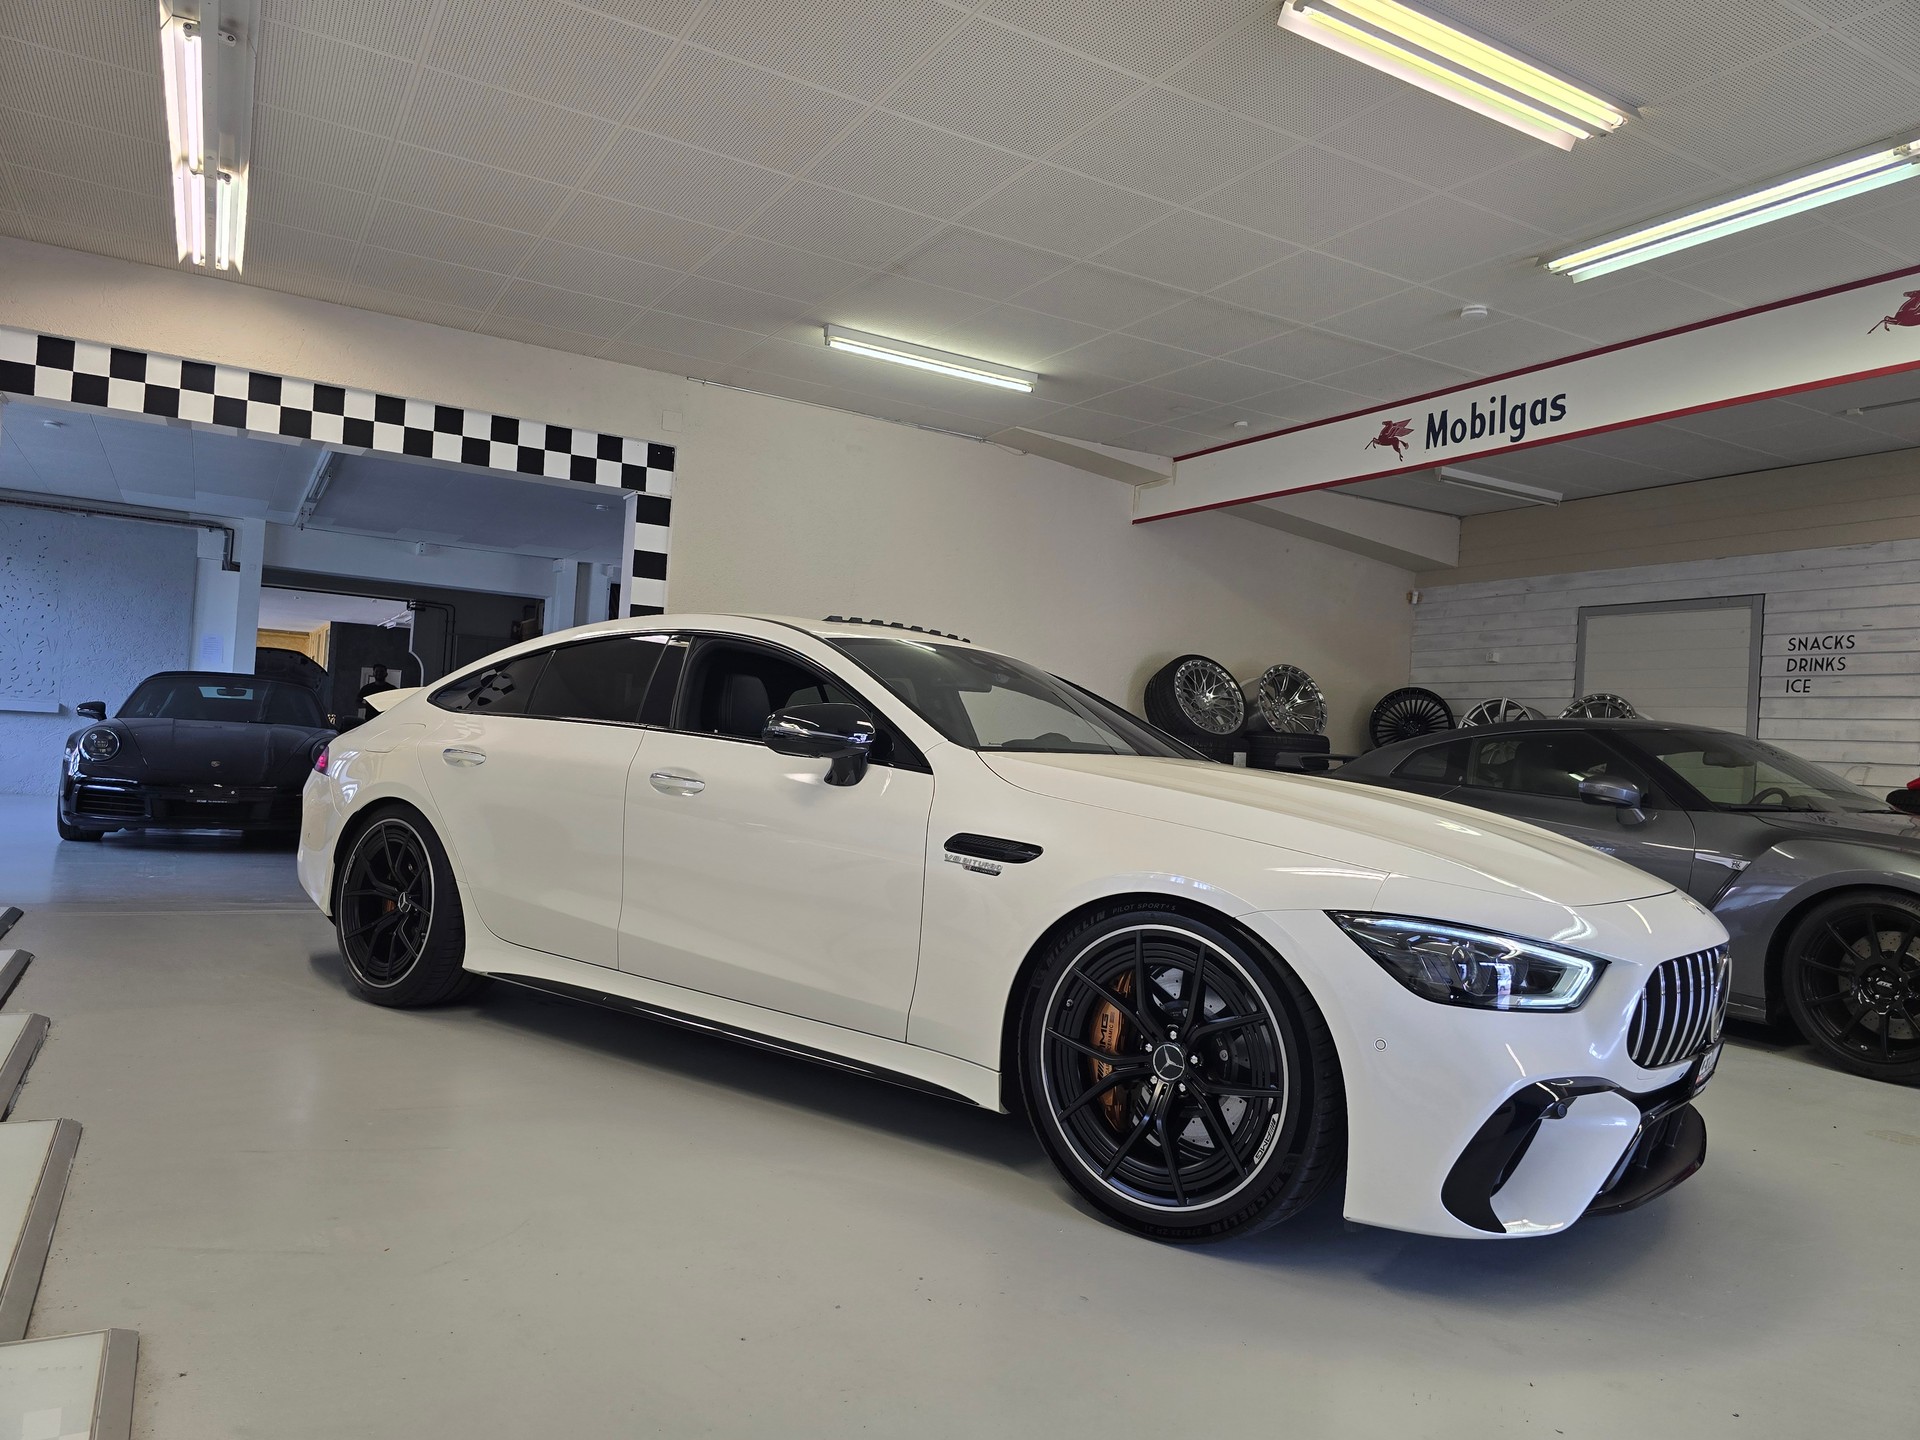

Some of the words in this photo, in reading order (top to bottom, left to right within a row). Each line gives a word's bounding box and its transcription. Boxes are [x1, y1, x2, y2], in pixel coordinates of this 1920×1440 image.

[1425, 393, 1567, 450] Mobilgas
[1787, 634, 1856, 652] SNACKS
[1786, 656, 1846, 672] DRINKS
[1785, 678, 1812, 693] ICE
[944, 853, 962, 862] V8
[962, 857, 1004, 871] BITURBO
[1112, 903, 1135, 915] PILOT
[1046, 909, 1107, 967] MICHELIN
[1255, 1132, 1273, 1160] AMG
[1209, 1175, 1286, 1235] MICHELIN
